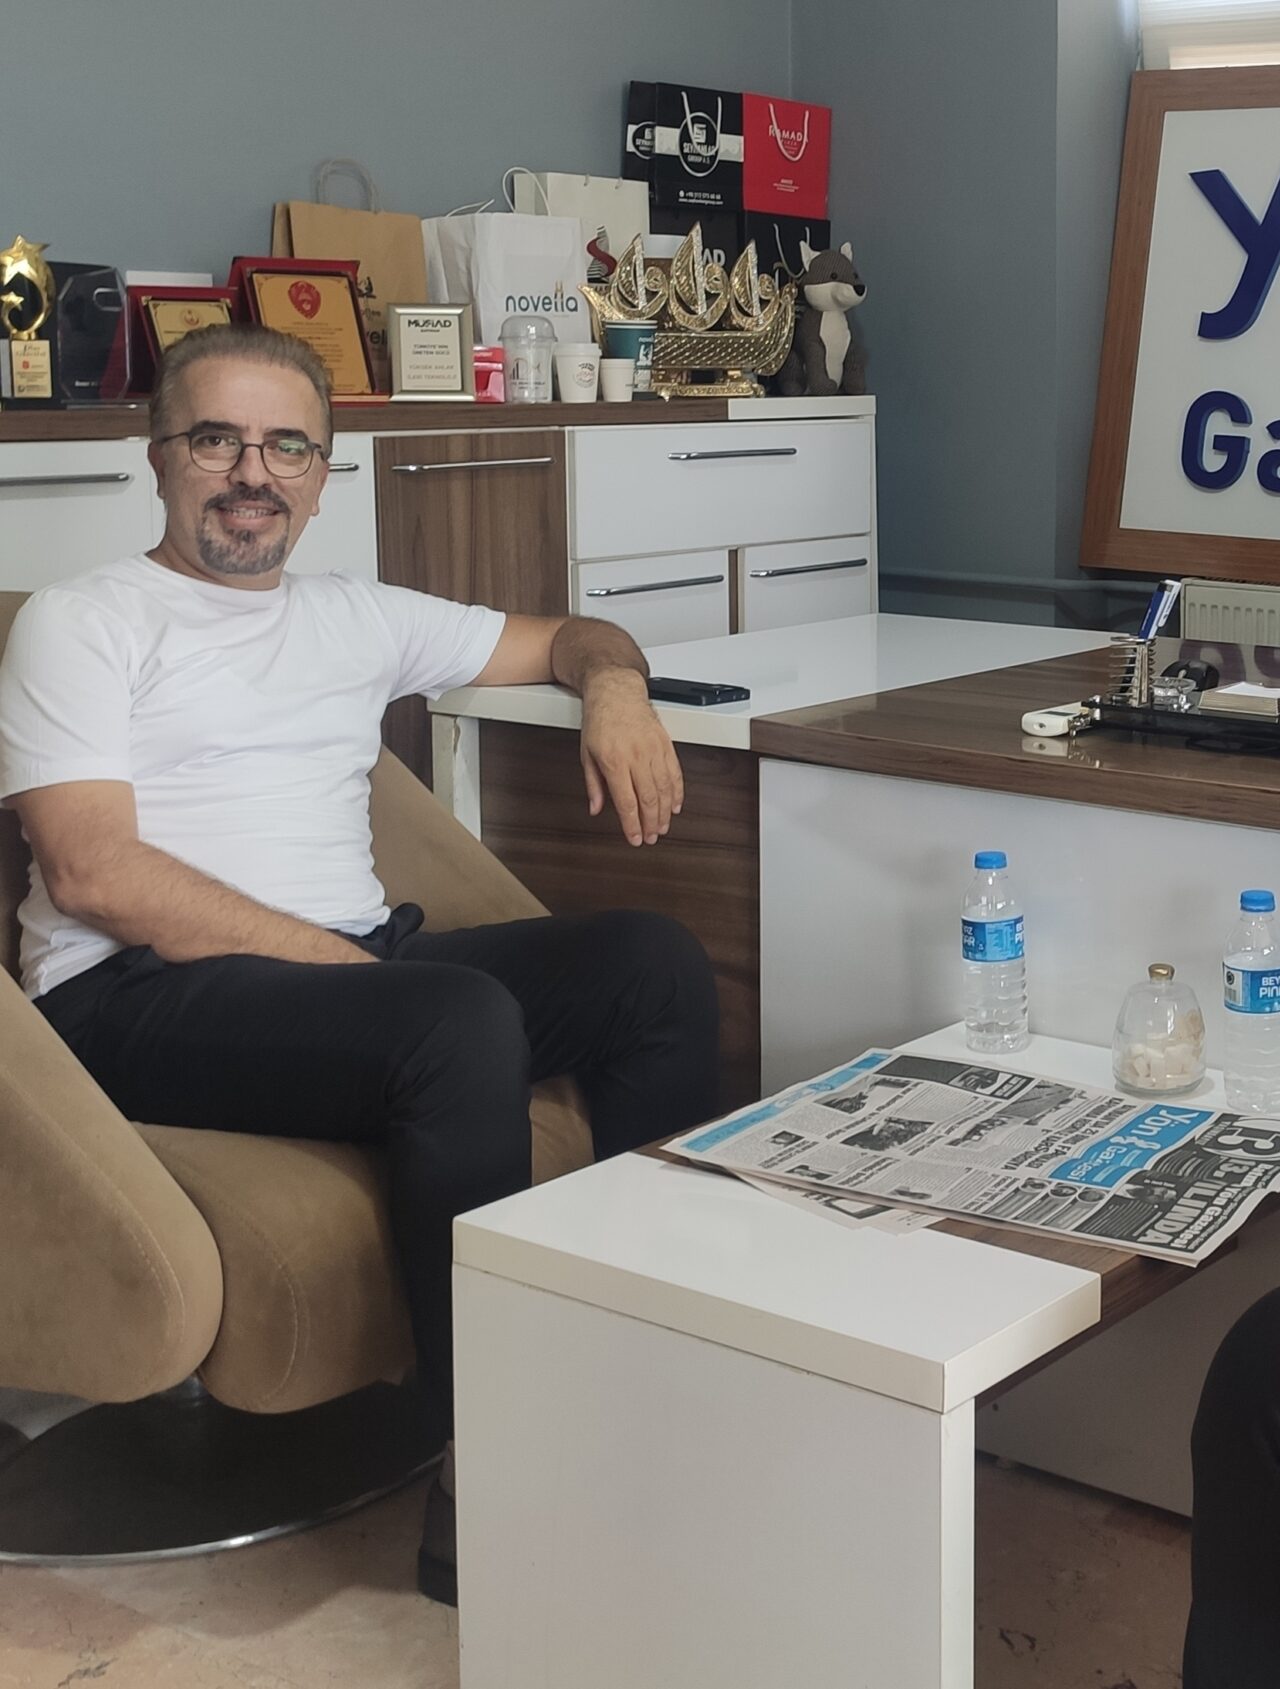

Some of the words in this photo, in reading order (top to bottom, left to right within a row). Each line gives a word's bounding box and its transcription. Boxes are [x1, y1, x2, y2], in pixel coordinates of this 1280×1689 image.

[769, 125, 808, 143] RMAD
[505, 281, 578, 313] novella
[1131, 1108, 1199, 1136] Yön
[1066, 1145, 1129, 1181] Gatesi
[1234, 1163, 1274, 1188] Batm
[1170, 1206, 1222, 1249] Gazetesi
